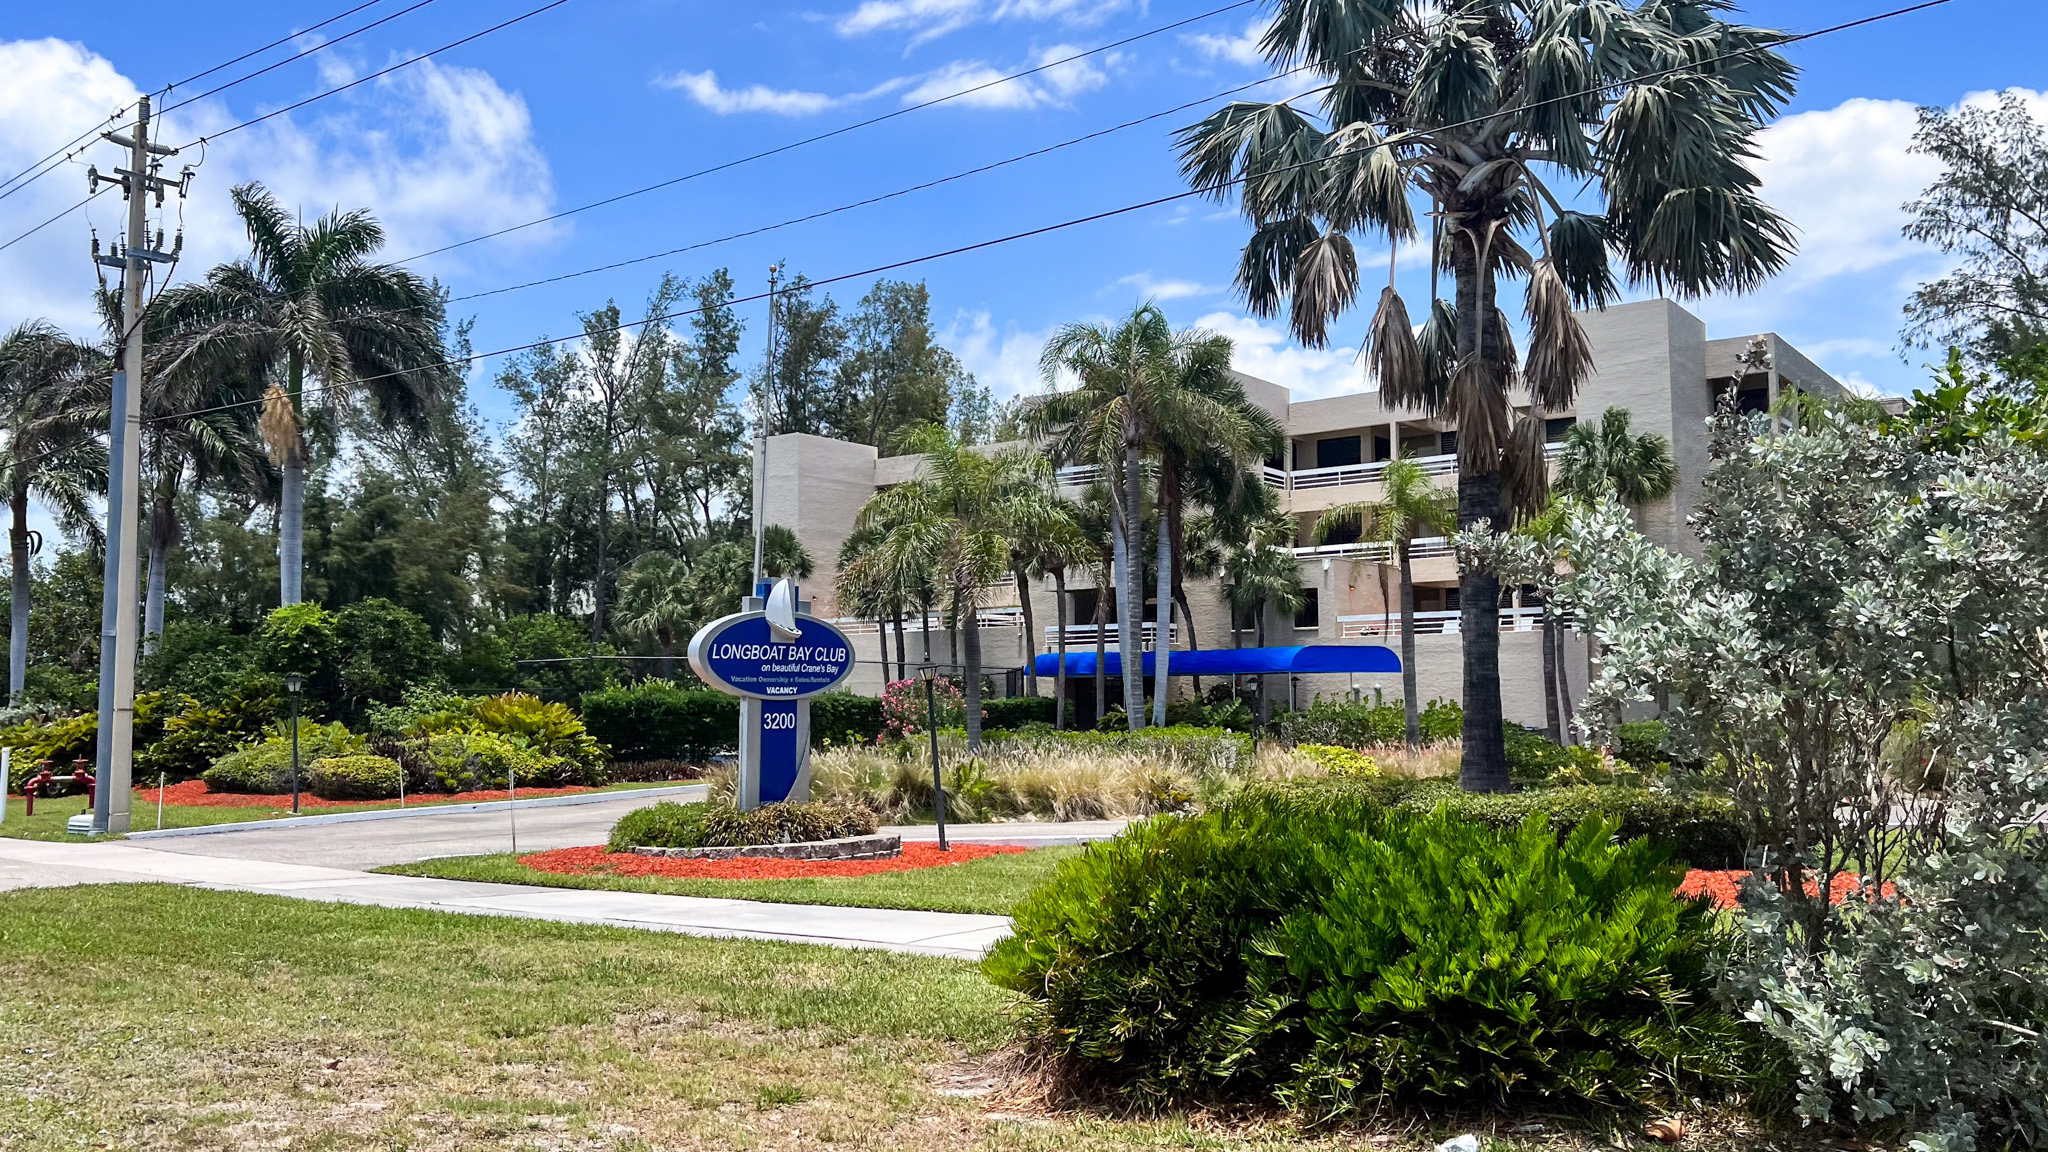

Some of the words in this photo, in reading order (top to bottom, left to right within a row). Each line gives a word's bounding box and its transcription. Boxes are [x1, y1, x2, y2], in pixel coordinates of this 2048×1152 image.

[712, 643, 786, 660] LONGBOAT
[788, 646, 813, 661] BAY
[814, 647, 846, 662] CLUB
[761, 664, 771, 672] on
[772, 663, 800, 673] beautiful
[801, 663, 825, 673] Crane's
[826, 665, 839, 675] Bay
[731, 675, 757, 683] Vacation
[758, 676, 789, 684] Ownership
[766, 686, 798, 695] VACANCY
[763, 713, 796, 729] 3200
